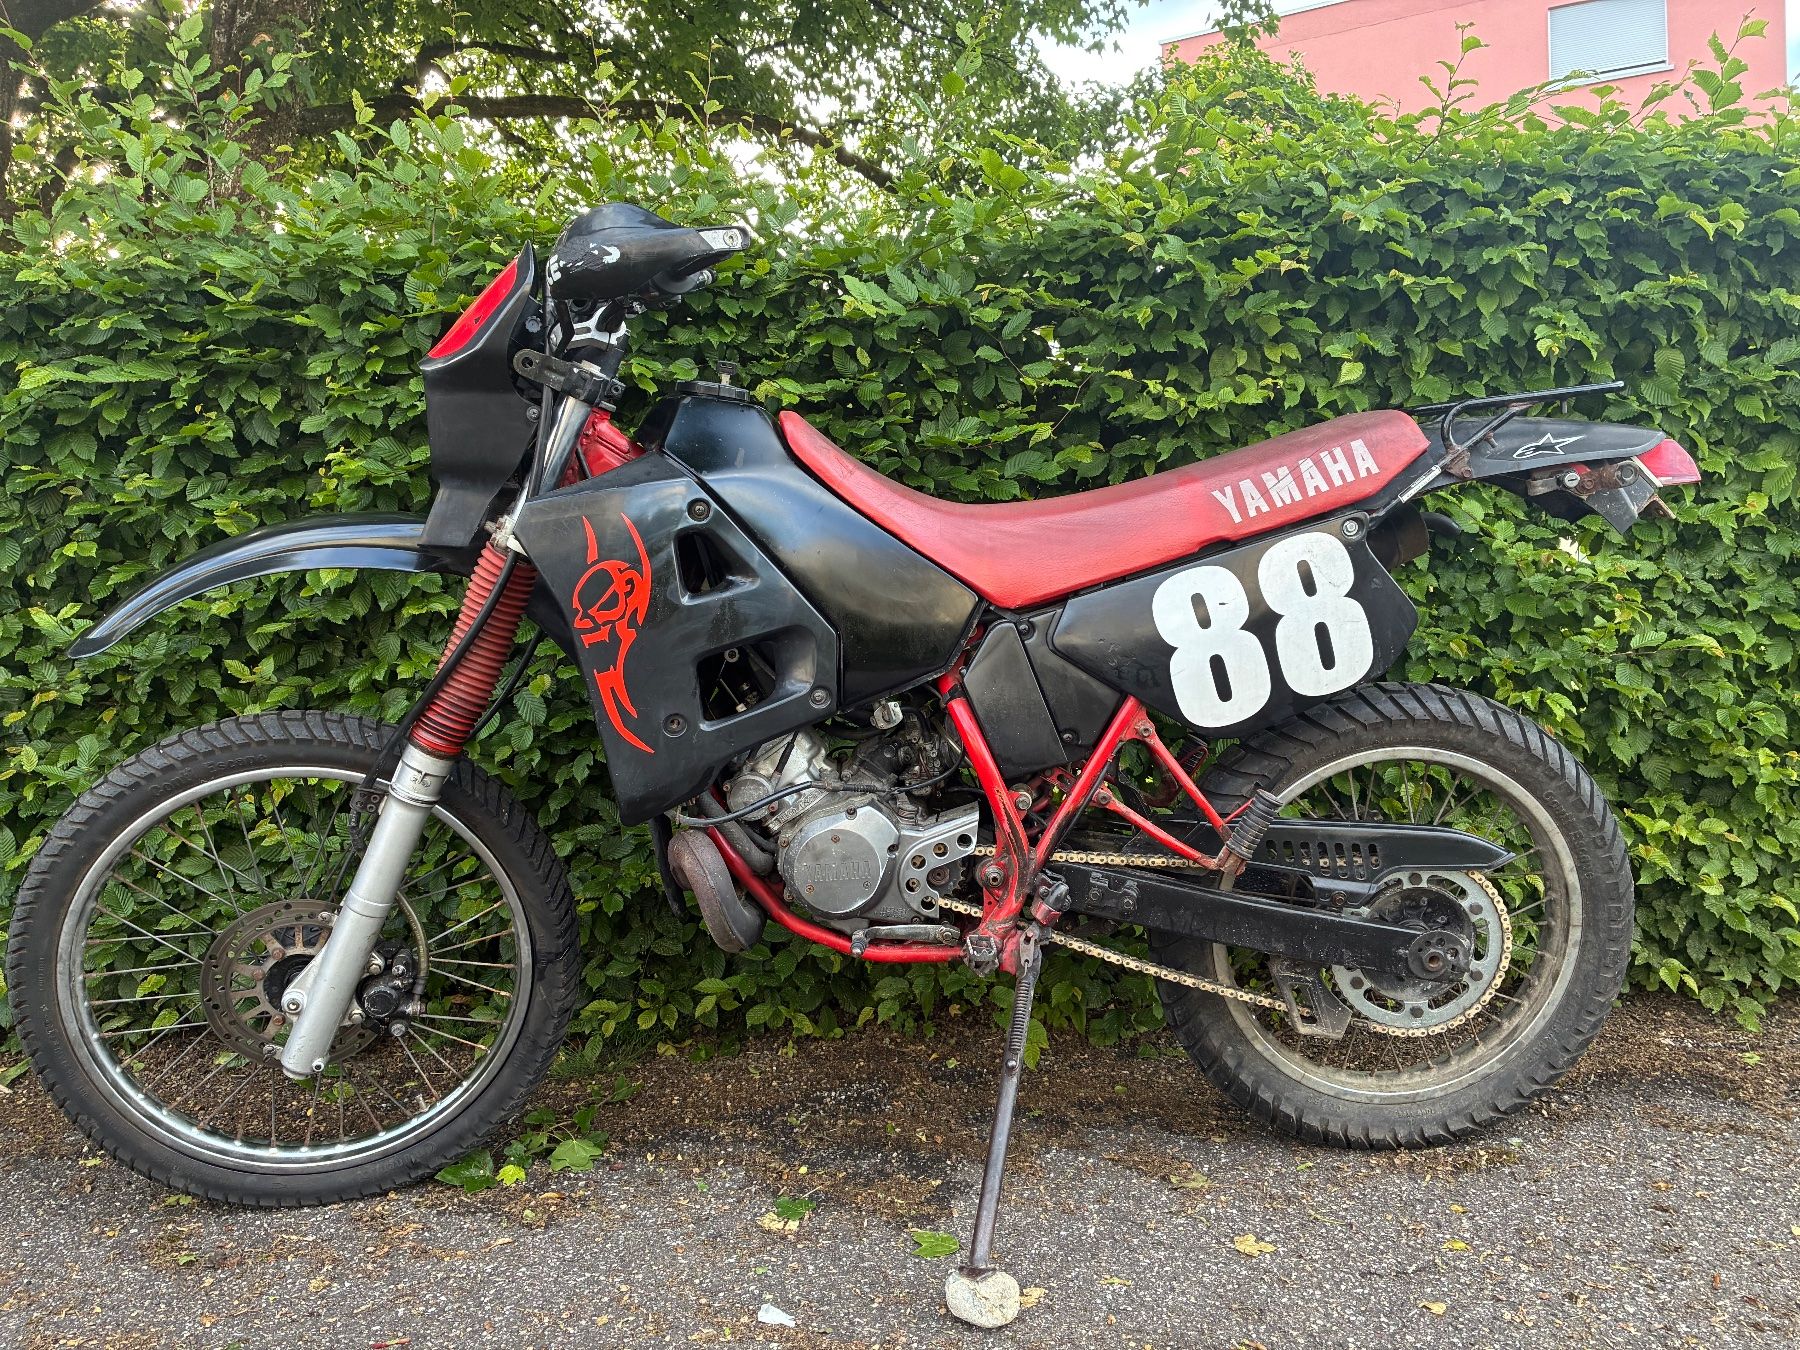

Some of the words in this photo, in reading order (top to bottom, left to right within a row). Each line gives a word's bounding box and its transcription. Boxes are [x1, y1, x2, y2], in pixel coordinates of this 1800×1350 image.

[1211, 438, 1380, 524] YAMAHA
[1152, 531, 1374, 728] 88
[803, 860, 872, 883] YAMAHA
